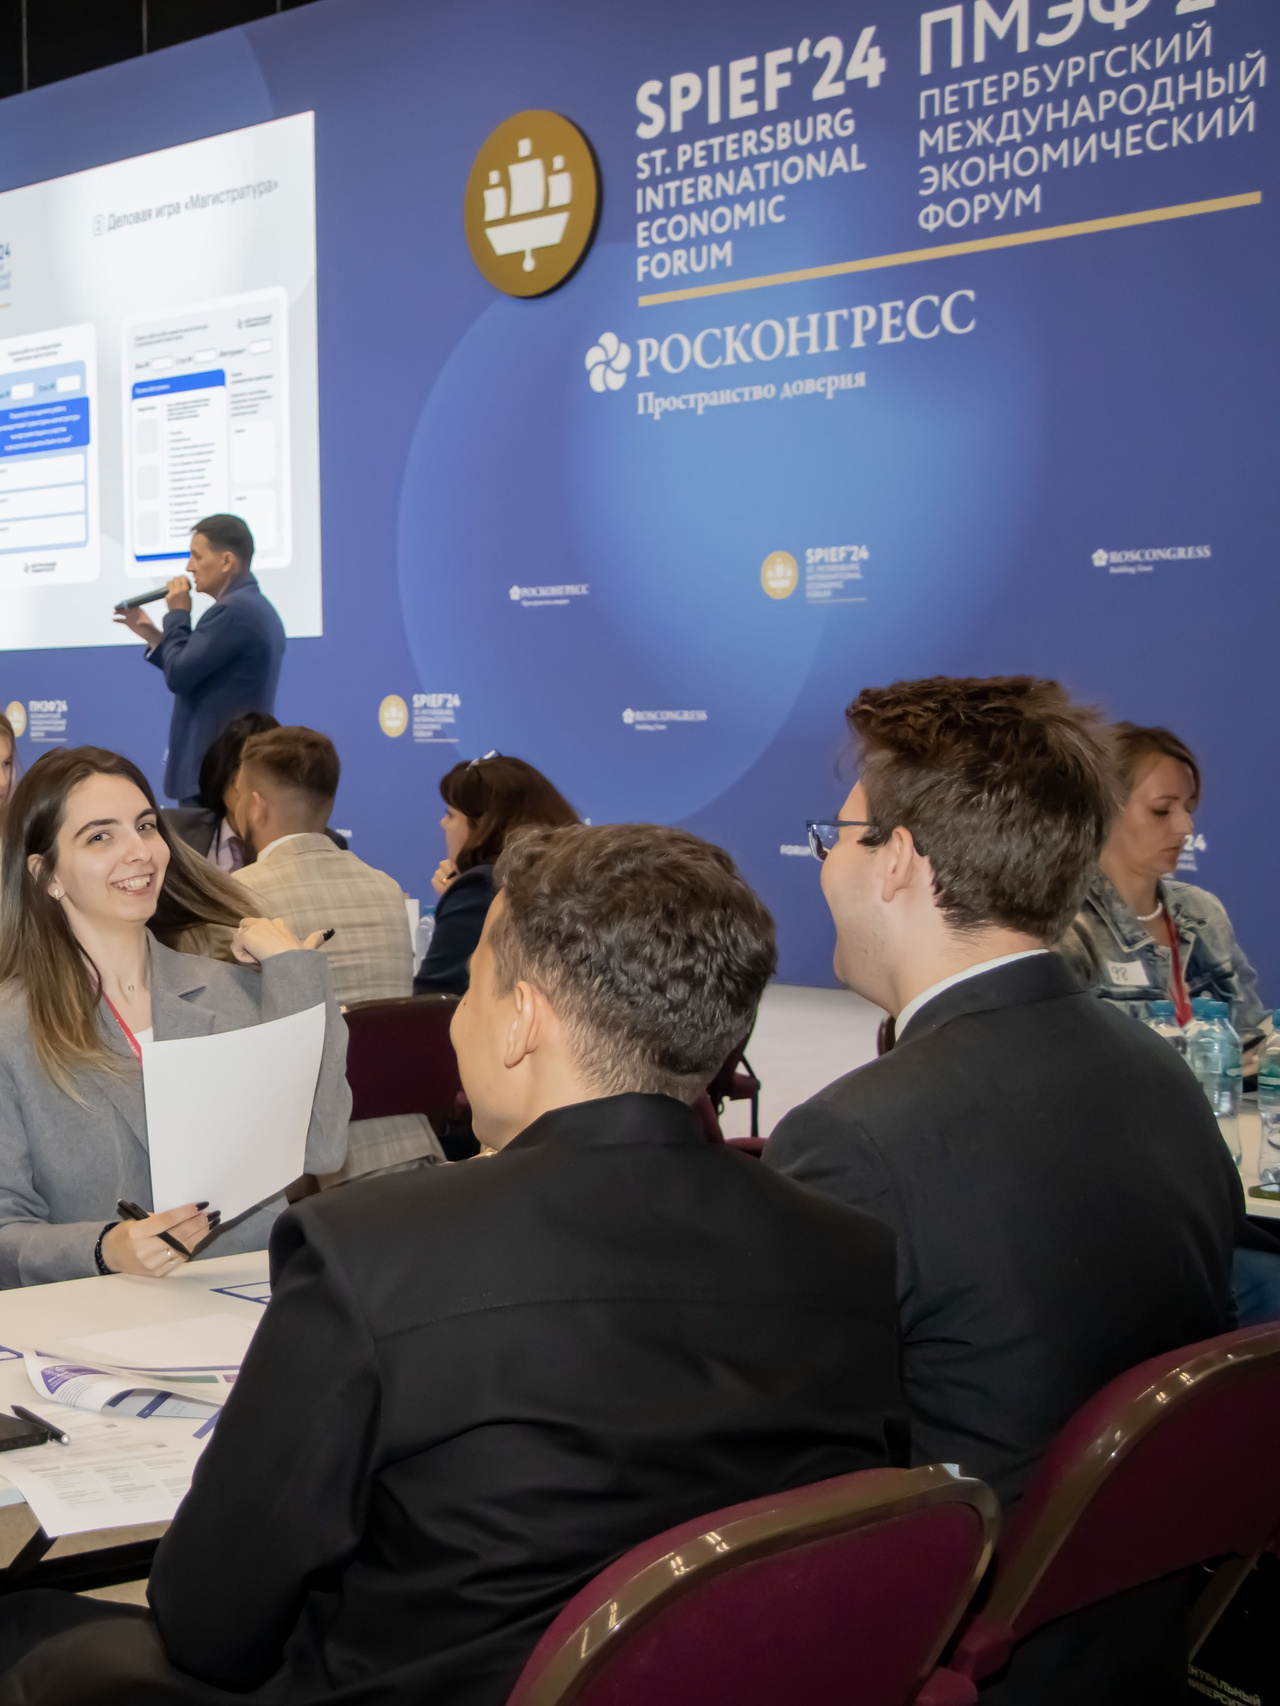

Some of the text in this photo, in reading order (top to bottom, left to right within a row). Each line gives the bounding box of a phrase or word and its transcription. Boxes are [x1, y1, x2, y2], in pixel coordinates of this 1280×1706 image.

[919, 51, 1266, 158] МЕЖДУНАРОДНЫЙ
[920, 20, 1212, 119] ПЕТЕРБУРГСКИЙ
[636, 108, 855, 179] ST. PETERSBURG
[919, 95, 1256, 196] ЭКОНОМИЧЕСКИЙ
[637, 144, 866, 214] INTERNATIONAL
[918, 184, 1042, 233] ФОРУМ
[637, 195, 786, 249] ECONOMIC
[637, 240, 733, 282] FORUM
[636, 290, 976, 378] РОСКОНГРЕСС
[637, 371, 866, 420] Пространство доверия
[1109, 545, 1212, 563] ROSCONGRESS
